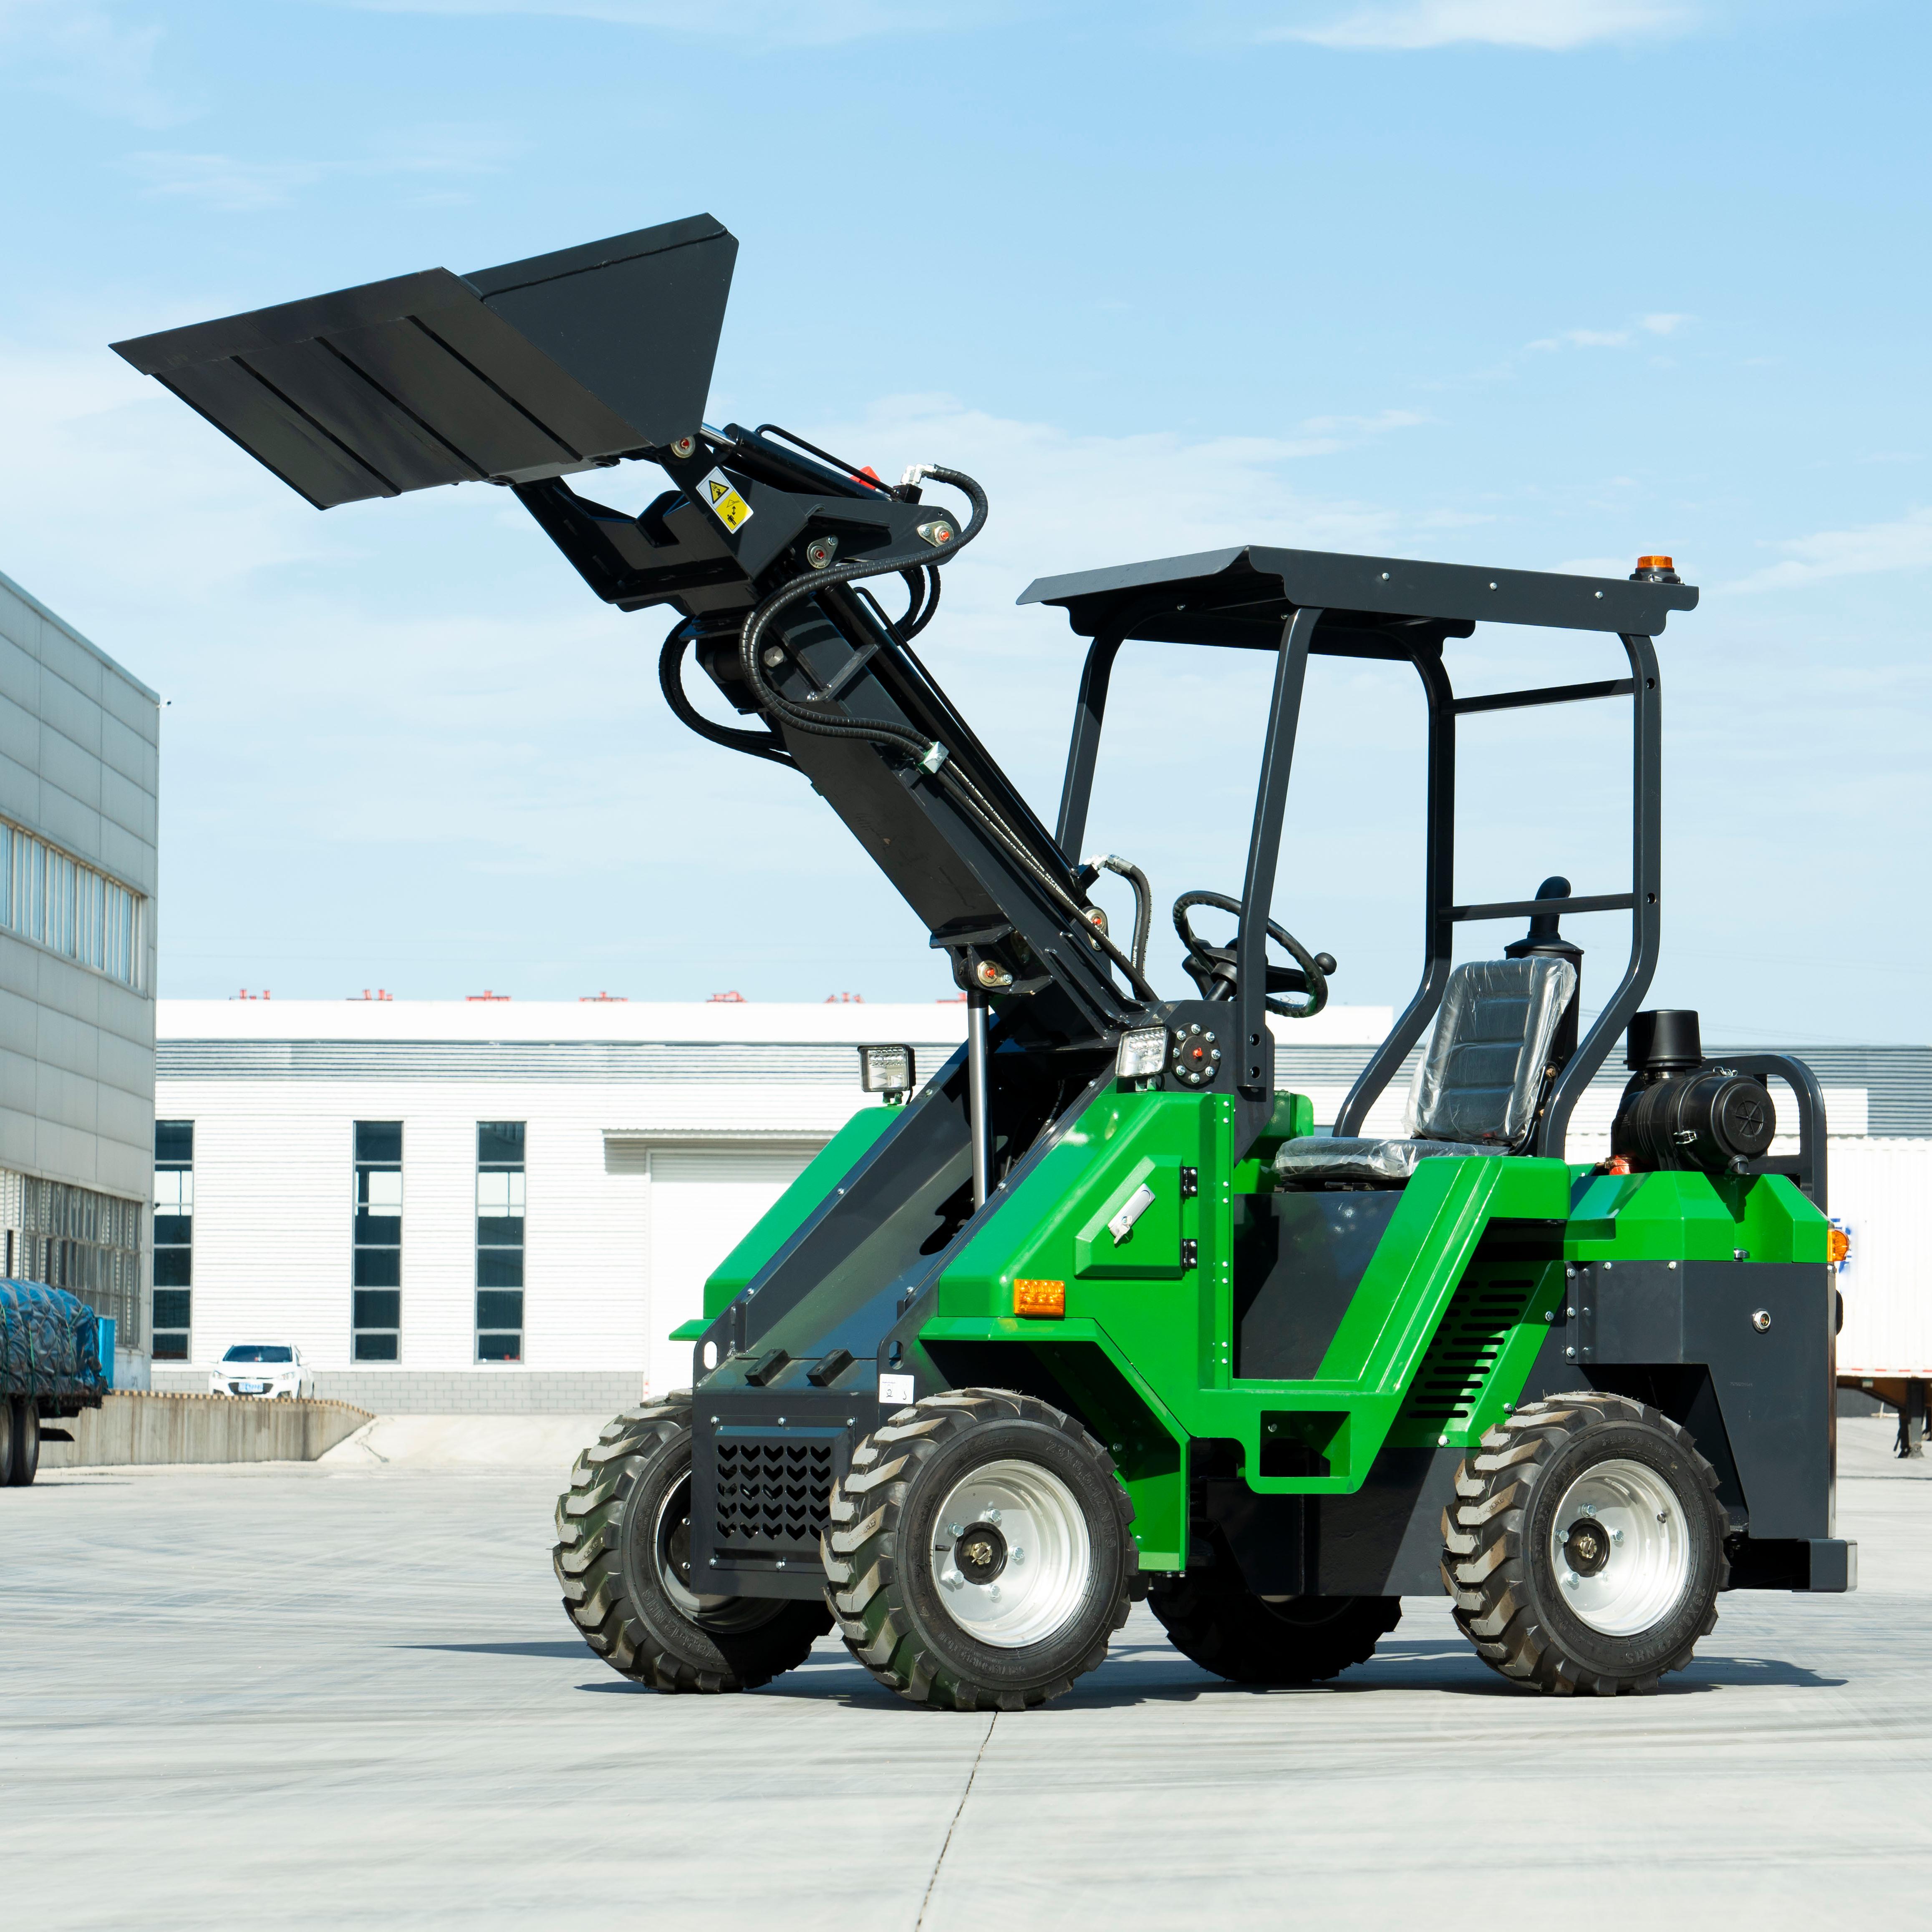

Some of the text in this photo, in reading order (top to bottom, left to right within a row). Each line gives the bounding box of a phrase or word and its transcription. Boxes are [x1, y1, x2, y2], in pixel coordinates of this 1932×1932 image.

[992, 810, 1001, 820] R2AT
[999, 818, 1011, 831] SAE100
[1009, 830, 1023, 846] EXCEEDS
[1100, 1509, 1117, 1548] NHS
[641, 1589, 667, 1624] NHS
[1625, 1645, 1655, 1664] NHS
